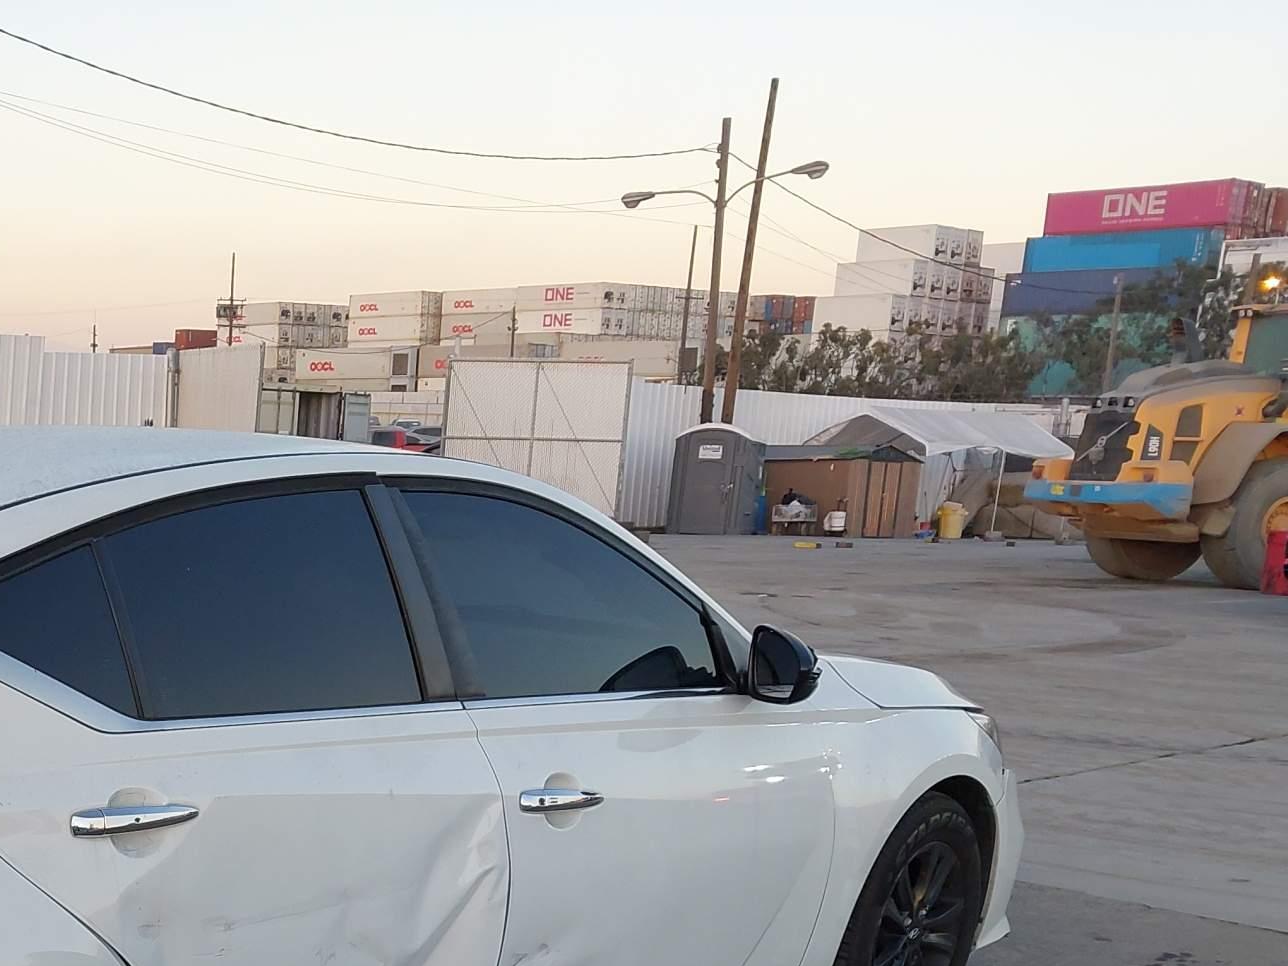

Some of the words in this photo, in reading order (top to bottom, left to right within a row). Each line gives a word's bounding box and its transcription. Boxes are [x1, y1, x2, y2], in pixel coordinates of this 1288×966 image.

[1101, 190, 1168, 218] ONE
[544, 287, 575, 302] ONE
[360, 303, 379, 312] OOCL
[454, 300, 474, 309] OOCL
[542, 313, 573, 328] ONE
[358, 327, 377, 336] OOCL
[452, 325, 473, 334] OOCL
[310, 361, 335, 372] OOCL
